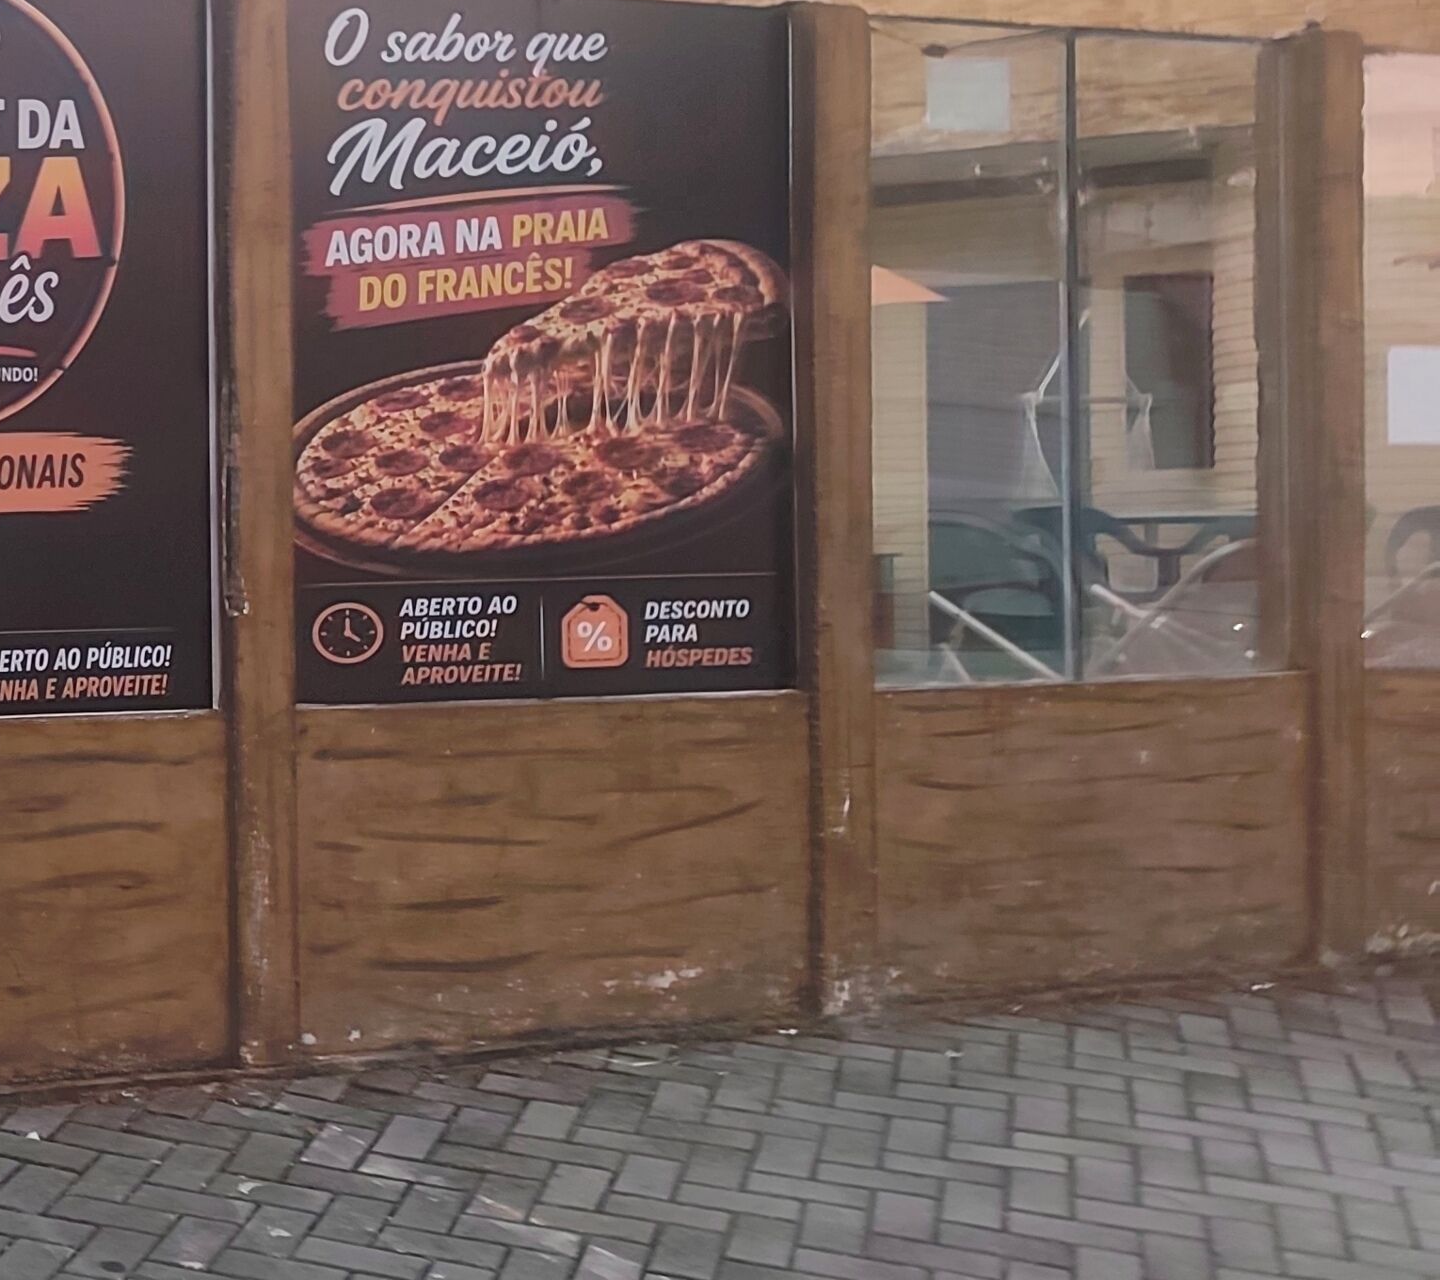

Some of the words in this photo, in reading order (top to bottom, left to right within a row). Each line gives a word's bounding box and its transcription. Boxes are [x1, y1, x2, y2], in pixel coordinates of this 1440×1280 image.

[324, 8, 370, 67] O
[381, 12, 517, 64] sabor
[526, 30, 609, 76] que
[337, 69, 606, 127] conquistou
[17, 99, 84, 149] DA
[327, 117, 603, 196] Maceió,
[325, 222, 445, 268] AGORA
[456, 217, 502, 253] NA
[512, 208, 609, 249] PRAIA
[358, 274, 406, 312] DO
[417, 253, 574, 305] FRANCÊS!
[399, 596, 483, 617] ABERTO
[487, 595, 518, 615] AO
[644, 599, 751, 621] DESCONTO
[400, 617, 498, 640] PÚBLICO!
[644, 624, 699, 644] PARA
[53, 647, 83, 671] AO
[86, 641, 172, 670] PÚBLICO!
[401, 643, 475, 664] VENHA
[478, 643, 492, 661] E
[645, 644, 753, 669] HÓSPEDES
[45, 677, 56, 700] E
[60, 673, 169, 699] APROVEITE!
[401, 663, 522, 686] APROVEITE!
